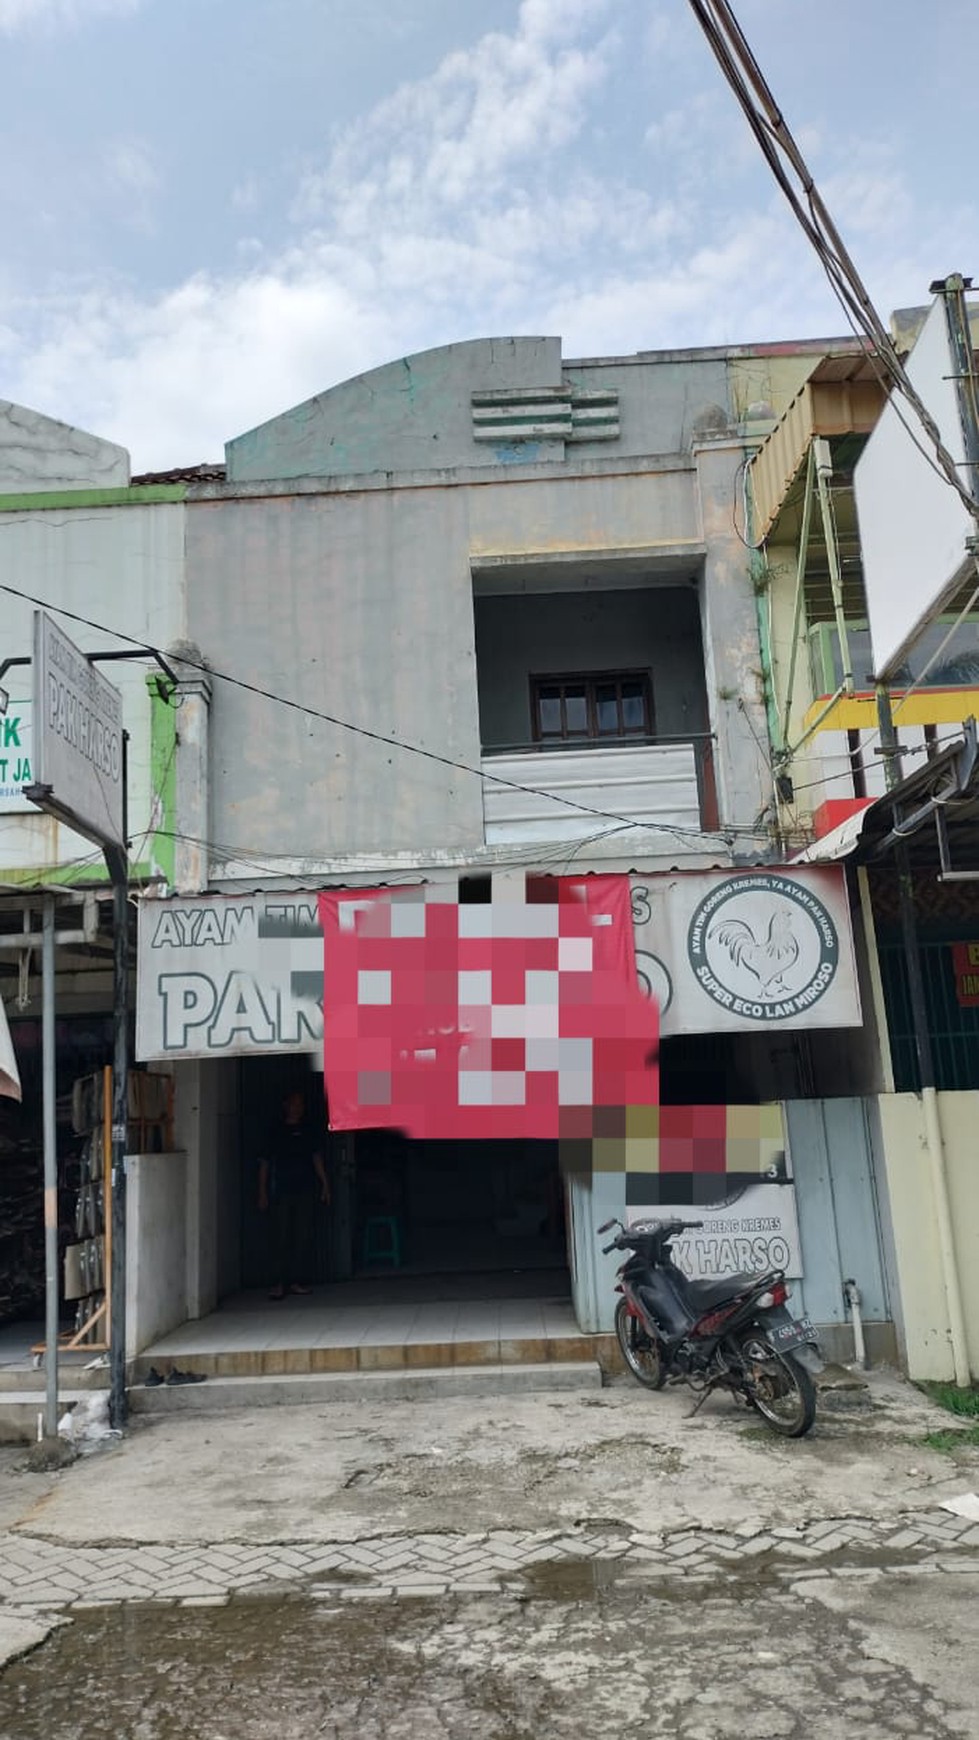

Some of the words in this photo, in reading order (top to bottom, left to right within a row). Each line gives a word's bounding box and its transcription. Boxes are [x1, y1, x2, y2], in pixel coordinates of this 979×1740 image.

[704, 885, 733, 912] GORENG
[152, 906, 256, 948] AYAM
[697, 966, 733, 1006] SUPER
[733, 1002, 763, 1017] ECO
[765, 1001, 796, 1018] LAN
[794, 963, 832, 1008] MIROSO
[696, 1236, 789, 1274] HARSO
